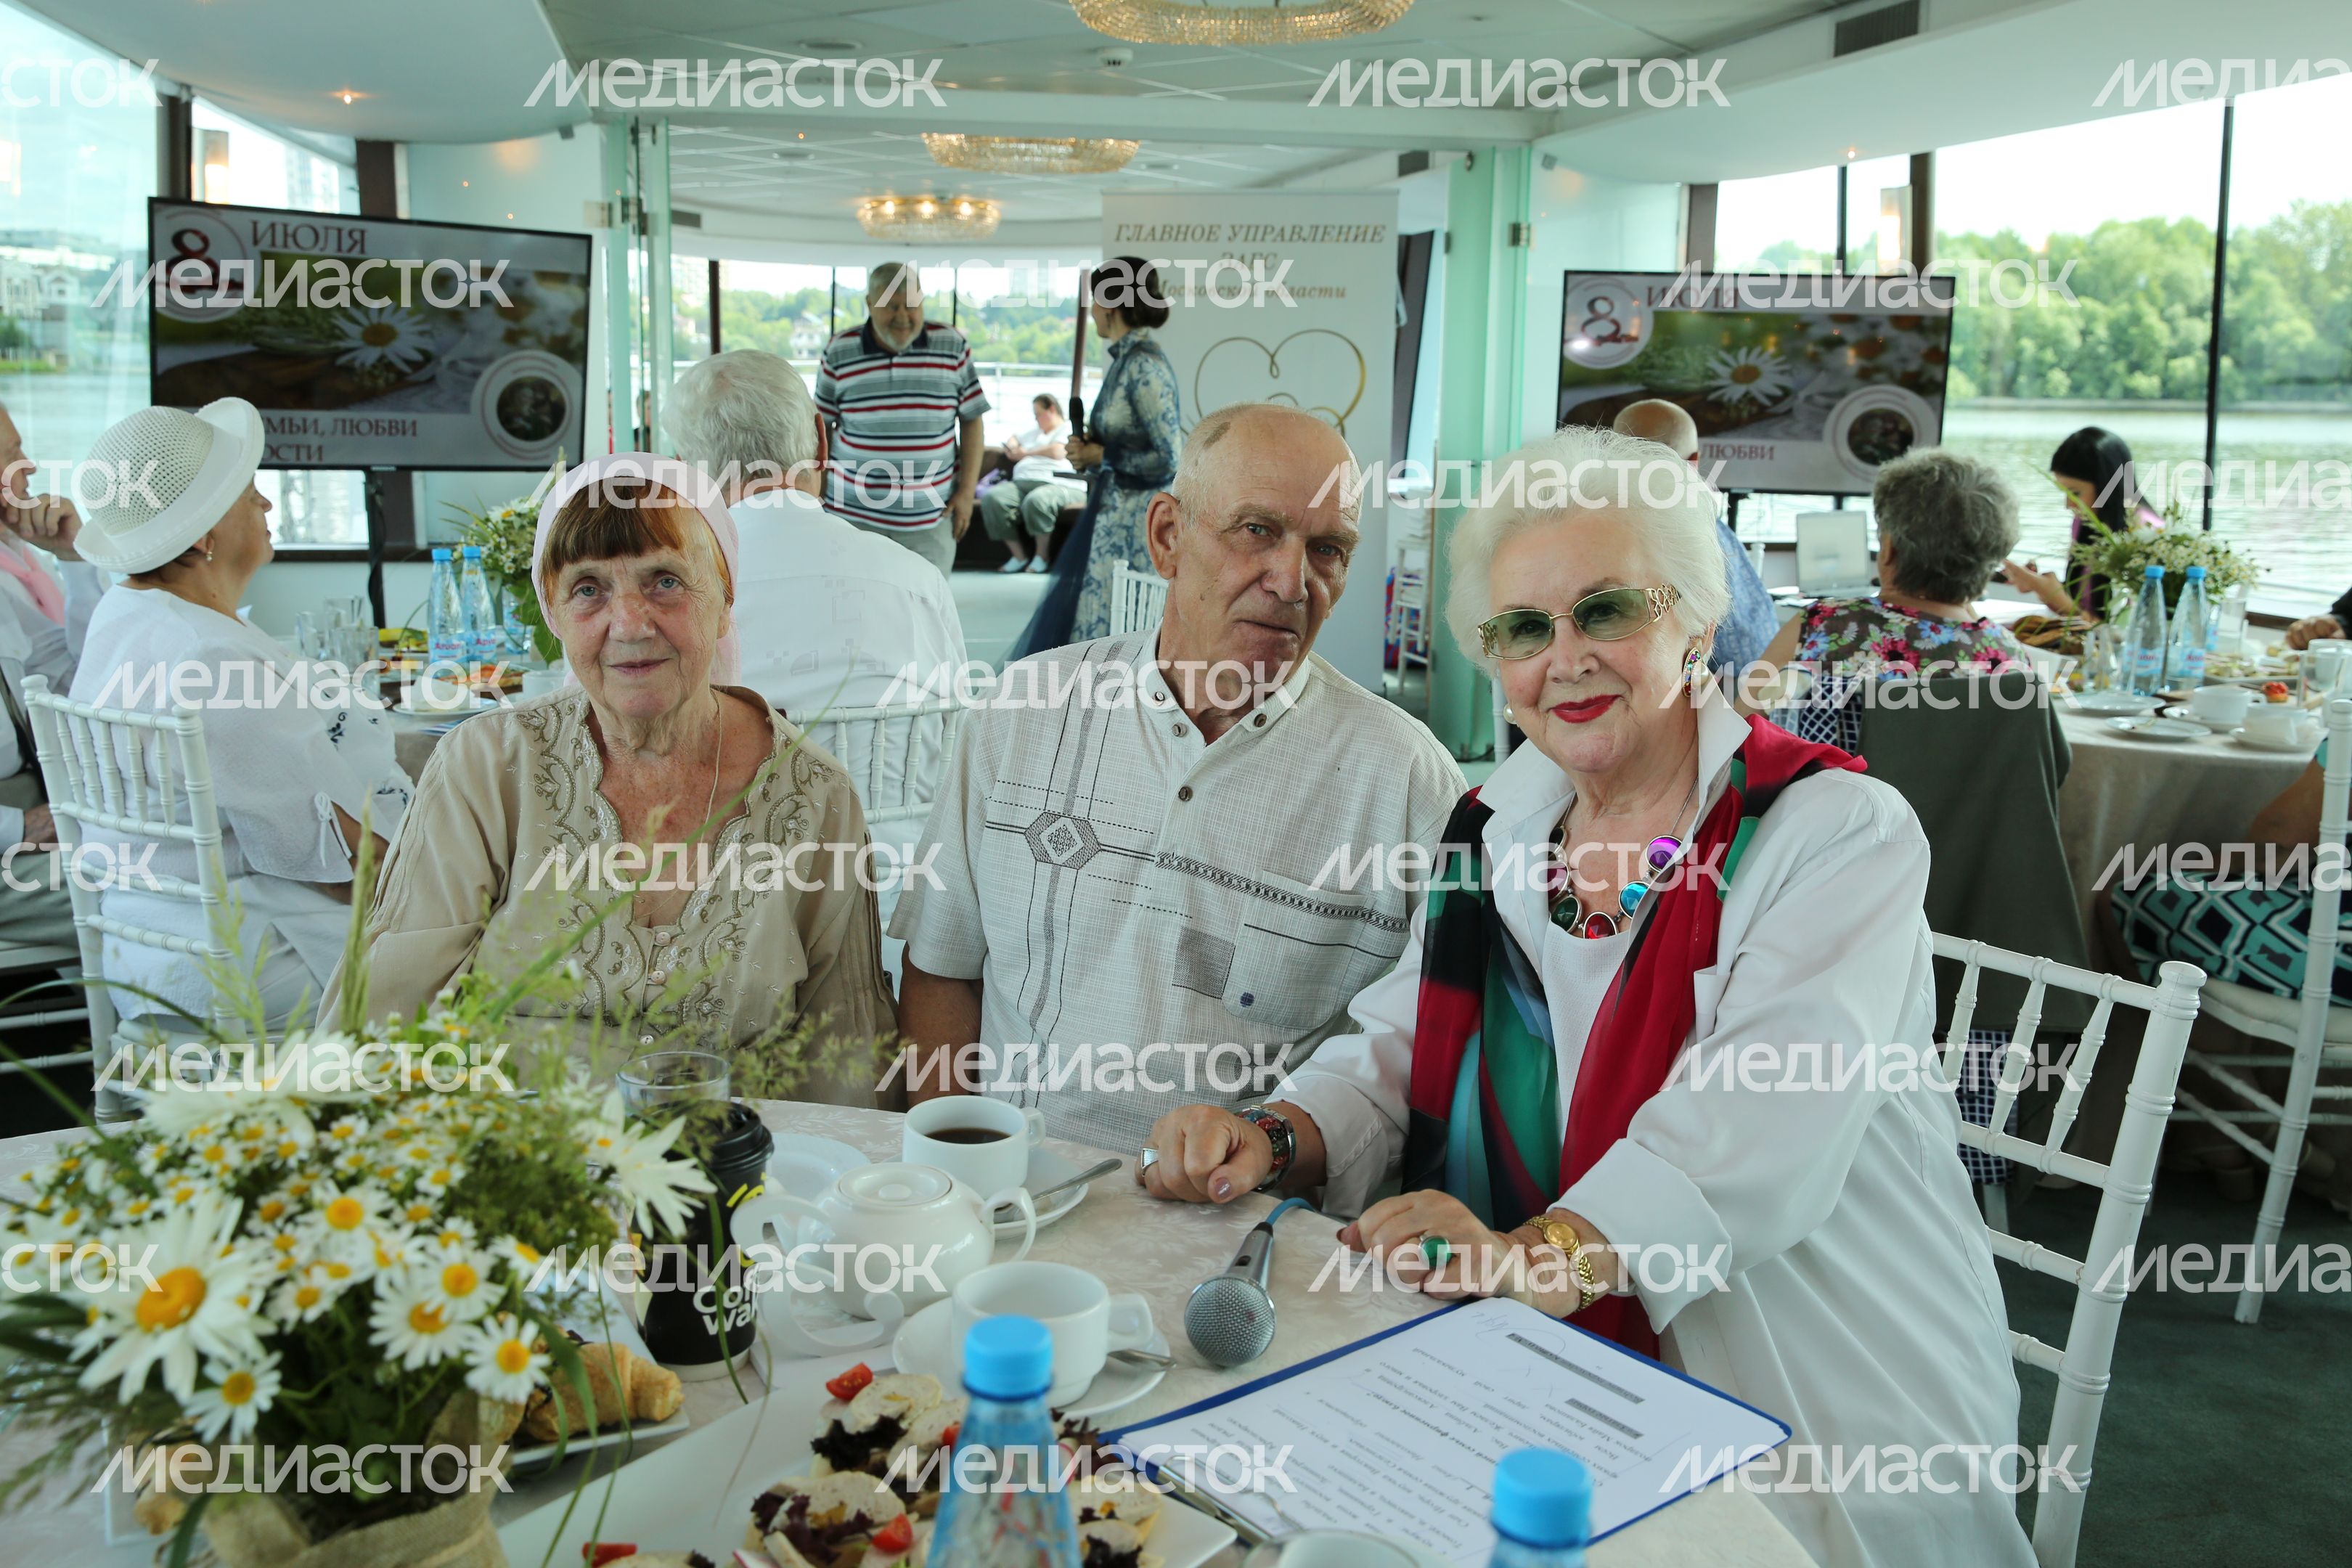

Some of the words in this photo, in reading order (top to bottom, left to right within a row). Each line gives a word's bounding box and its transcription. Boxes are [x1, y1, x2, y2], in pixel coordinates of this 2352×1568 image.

[250, 219, 367, 255] ИЮЛЯ
[1114, 224, 1221, 243] ГЛАВНОЕ
[1227, 224, 1387, 244] УПРАВЛЕНИЕ
[1646, 286, 1739, 309] ИЮЛЯ
[262, 417, 326, 437] МЬИ,
[332, 418, 418, 437] ЛЮБВИ
[1699, 444, 1775, 461] ЛЮБВИ
